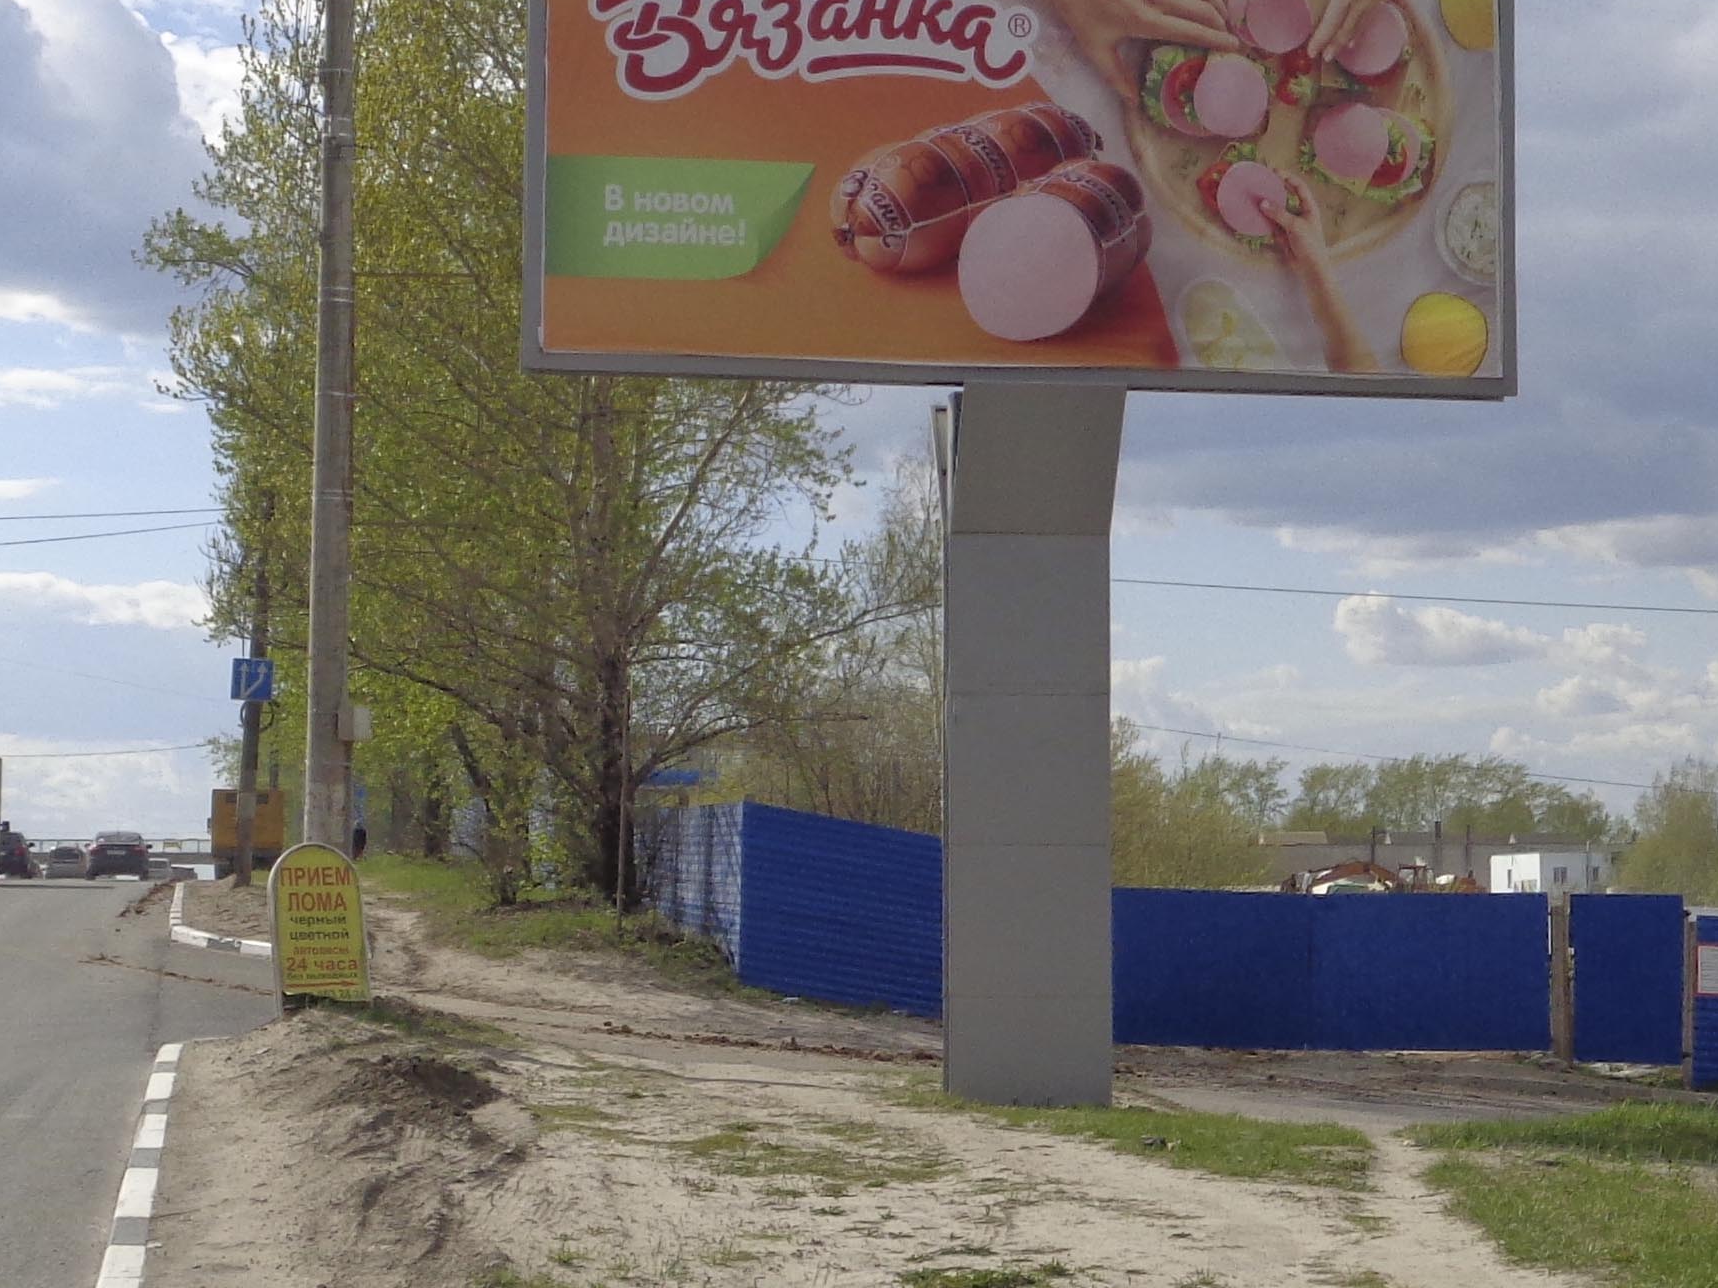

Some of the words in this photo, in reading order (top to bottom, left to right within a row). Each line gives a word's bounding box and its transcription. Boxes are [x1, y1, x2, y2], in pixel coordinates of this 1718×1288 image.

[604, 183, 624, 211] В
[634, 191, 733, 215] новом
[603, 217, 748, 247] дизайне!
[280, 866, 351, 886] ПРИЕМ
[288, 892, 347, 912] ЛОМА
[289, 928, 350, 942] цветной
[286, 957, 308, 971] 24
[314, 958, 358, 971] часа
